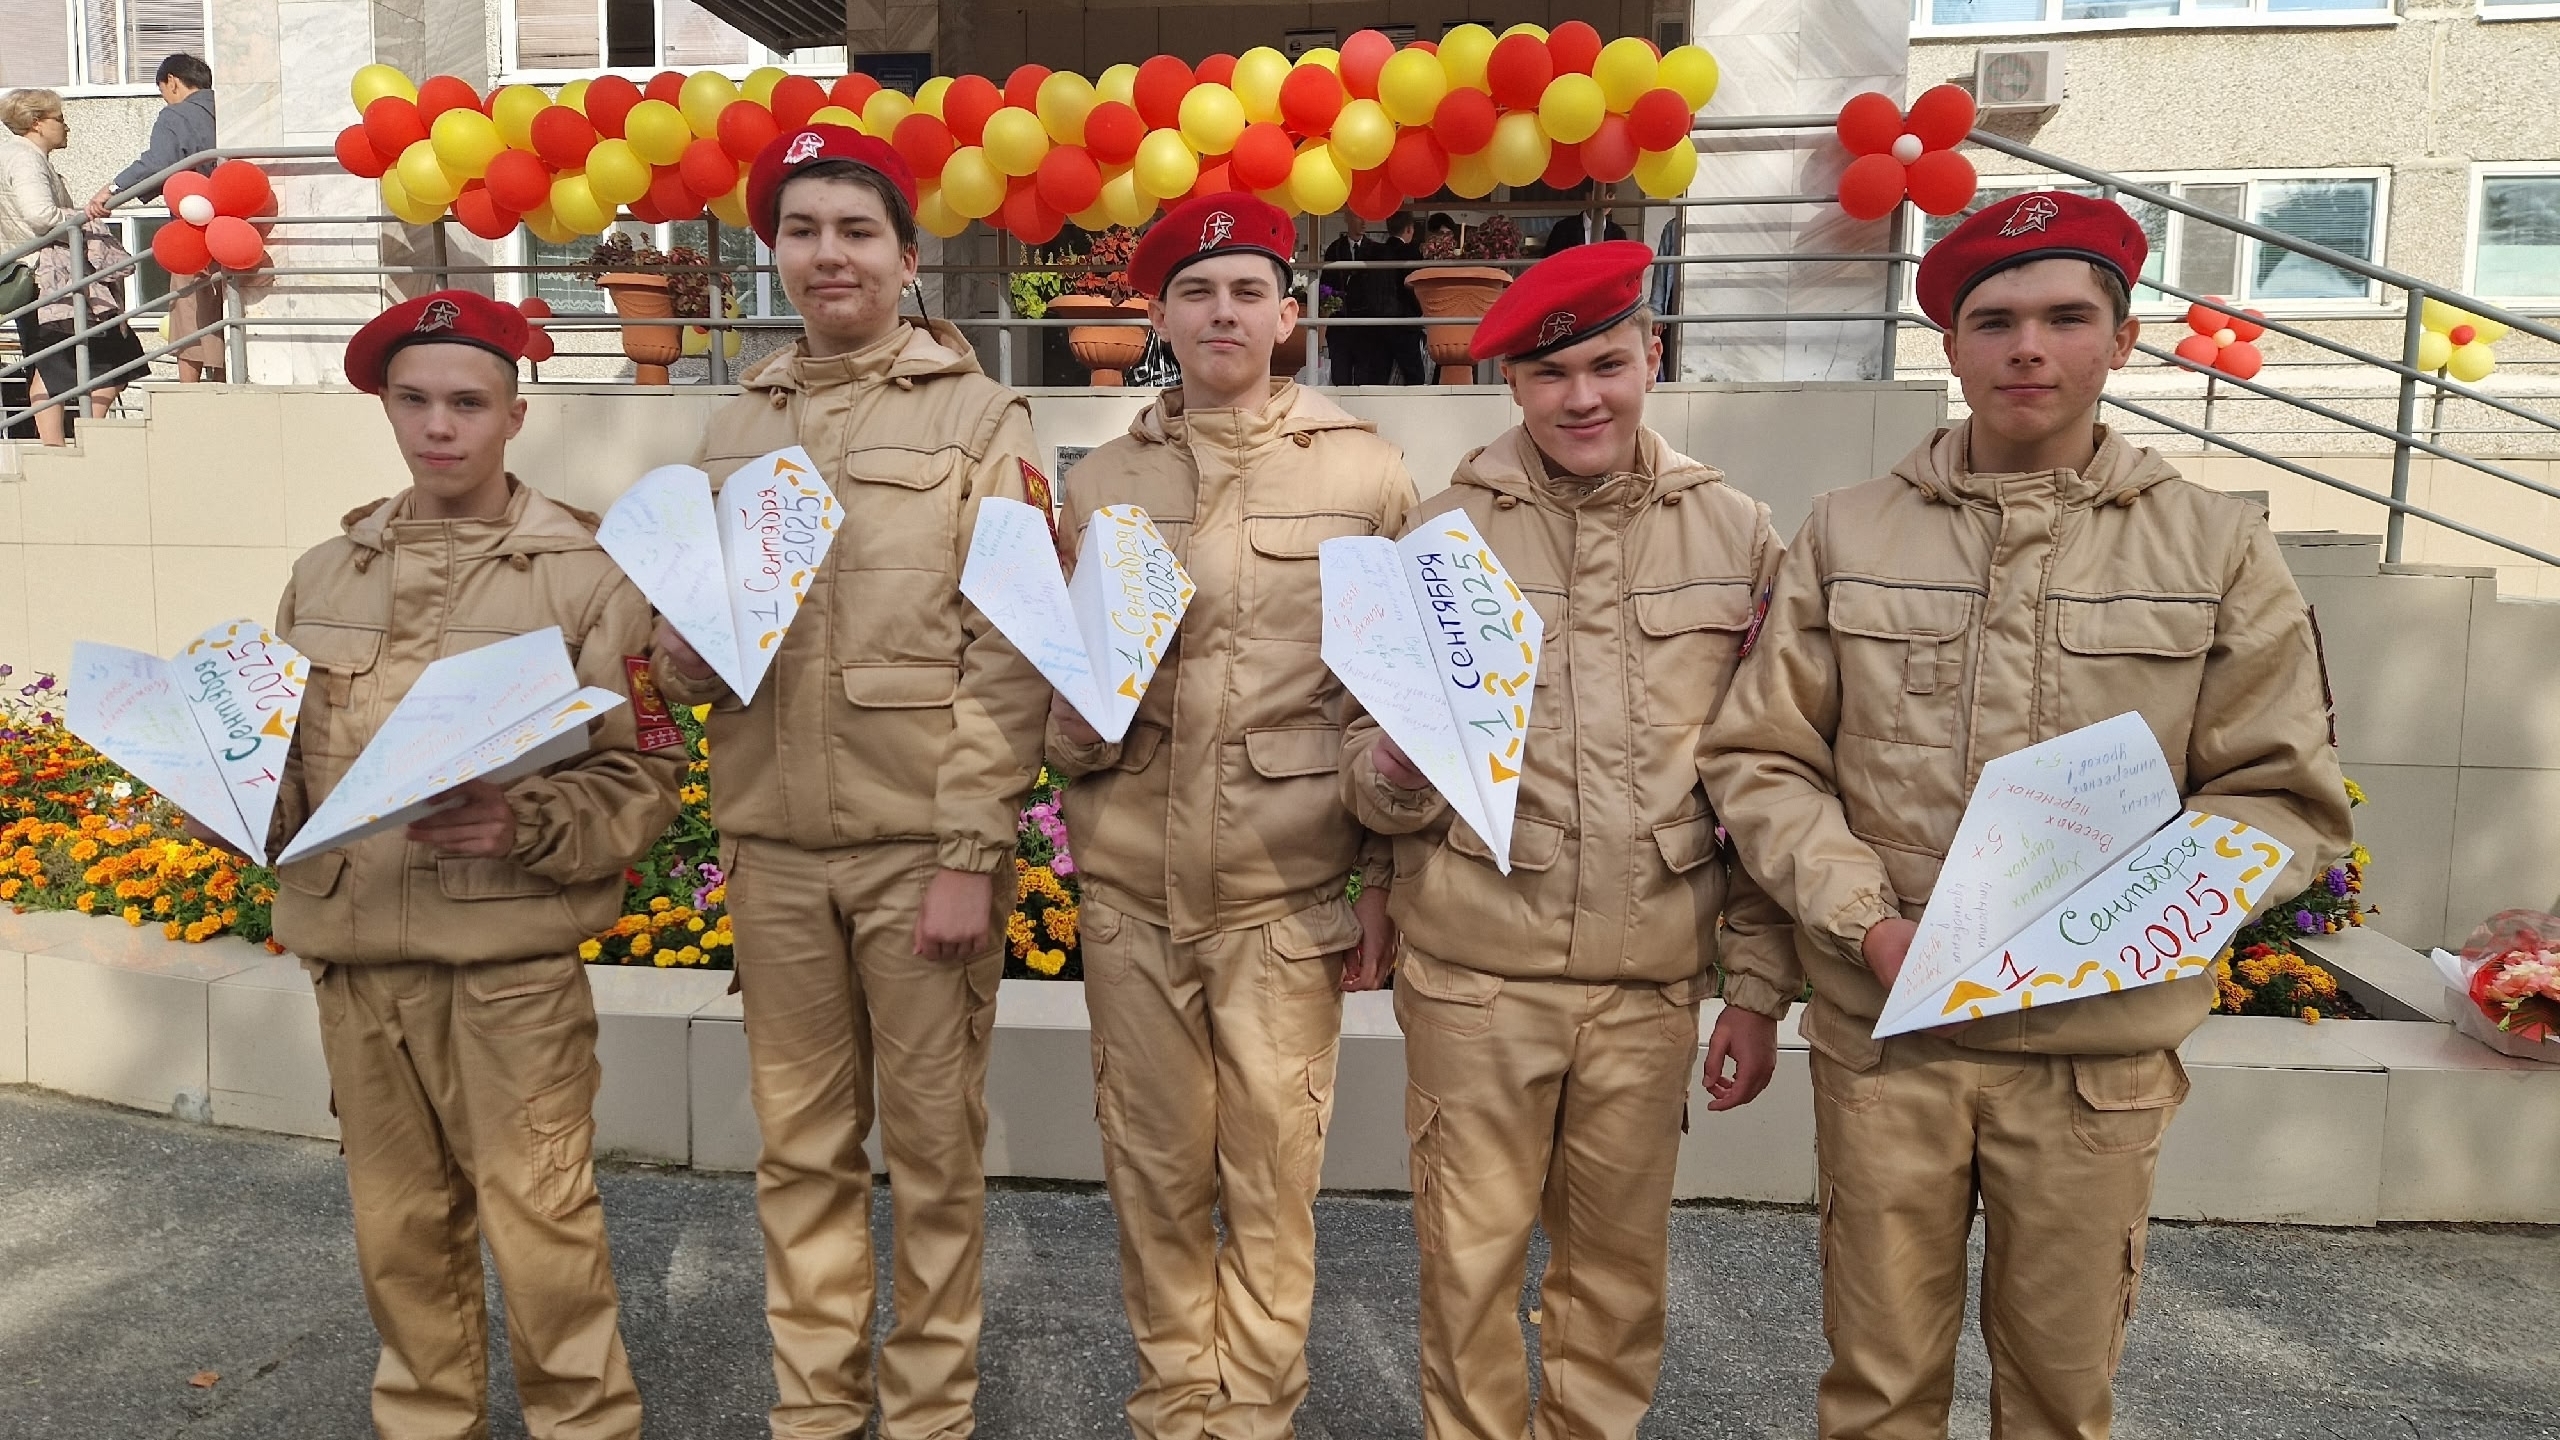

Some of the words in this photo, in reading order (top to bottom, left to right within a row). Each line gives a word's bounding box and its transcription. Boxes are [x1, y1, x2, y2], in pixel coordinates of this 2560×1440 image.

[739, 484, 782, 593] Сентября
[782, 496, 821, 566] 2025
[749, 600, 779, 624] 1
[1103, 530, 1146, 637] Сентября
[1142, 540, 1177, 616] 2025
[1452, 552, 1514, 642] 2025
[227, 640, 297, 711] 2025
[1115, 647, 1144, 672] 1
[189, 658, 262, 762] Сентября
[1469, 709, 1513, 738] 1
[237, 767, 277, 788] 1
[1997, 949, 2039, 991] 1
[2059, 835, 2210, 946] Сентября
[2120, 872, 2230, 981] 2025
